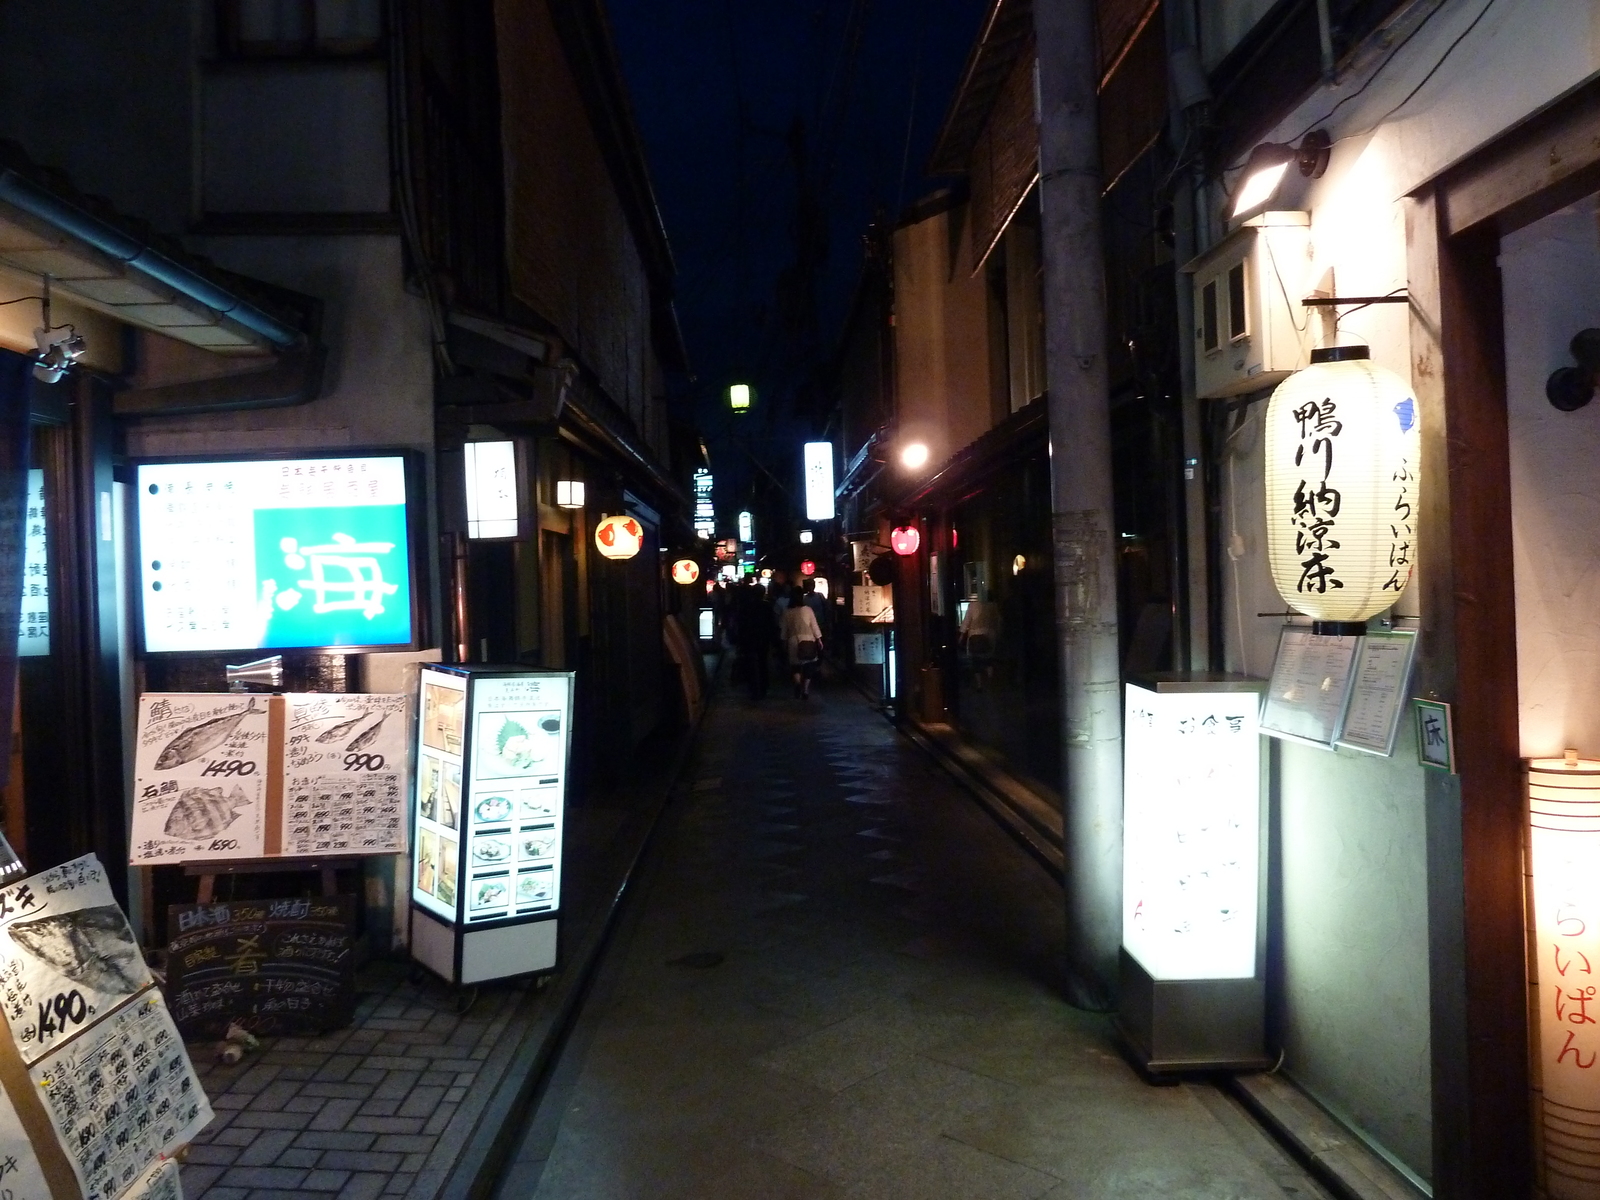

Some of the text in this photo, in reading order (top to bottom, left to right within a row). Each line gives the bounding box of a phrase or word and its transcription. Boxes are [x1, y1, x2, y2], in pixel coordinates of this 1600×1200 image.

[1291, 397, 1344, 593] 鴨川納涼床
[178, 903, 230, 931] 日本酒
[1552, 862, 1597, 1070] らいぱん
